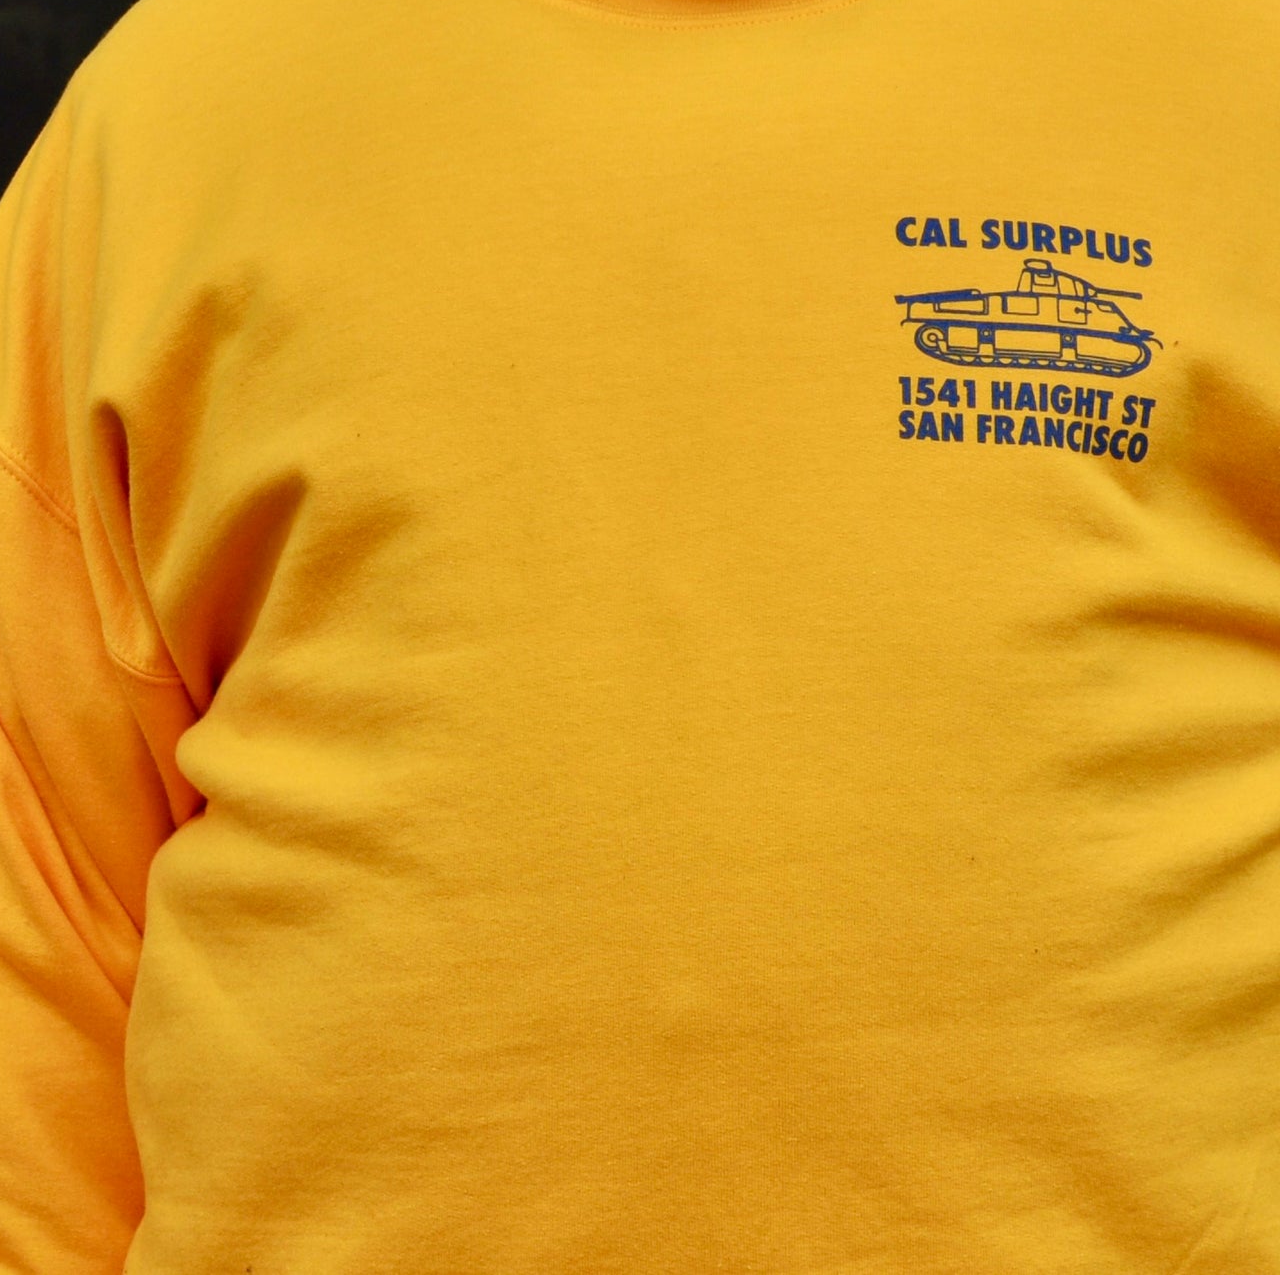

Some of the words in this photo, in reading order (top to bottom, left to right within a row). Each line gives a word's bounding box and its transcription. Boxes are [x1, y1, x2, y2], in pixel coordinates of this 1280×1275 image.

[895, 216, 968, 248] CAL
[981, 219, 1153, 268] SURPLUS
[898, 376, 977, 409] 1541
[990, 380, 1114, 420] HAIGHT
[1121, 395, 1157, 429] ST
[898, 410, 964, 443] SAN
[976, 414, 1149, 464] FRANCISCO
